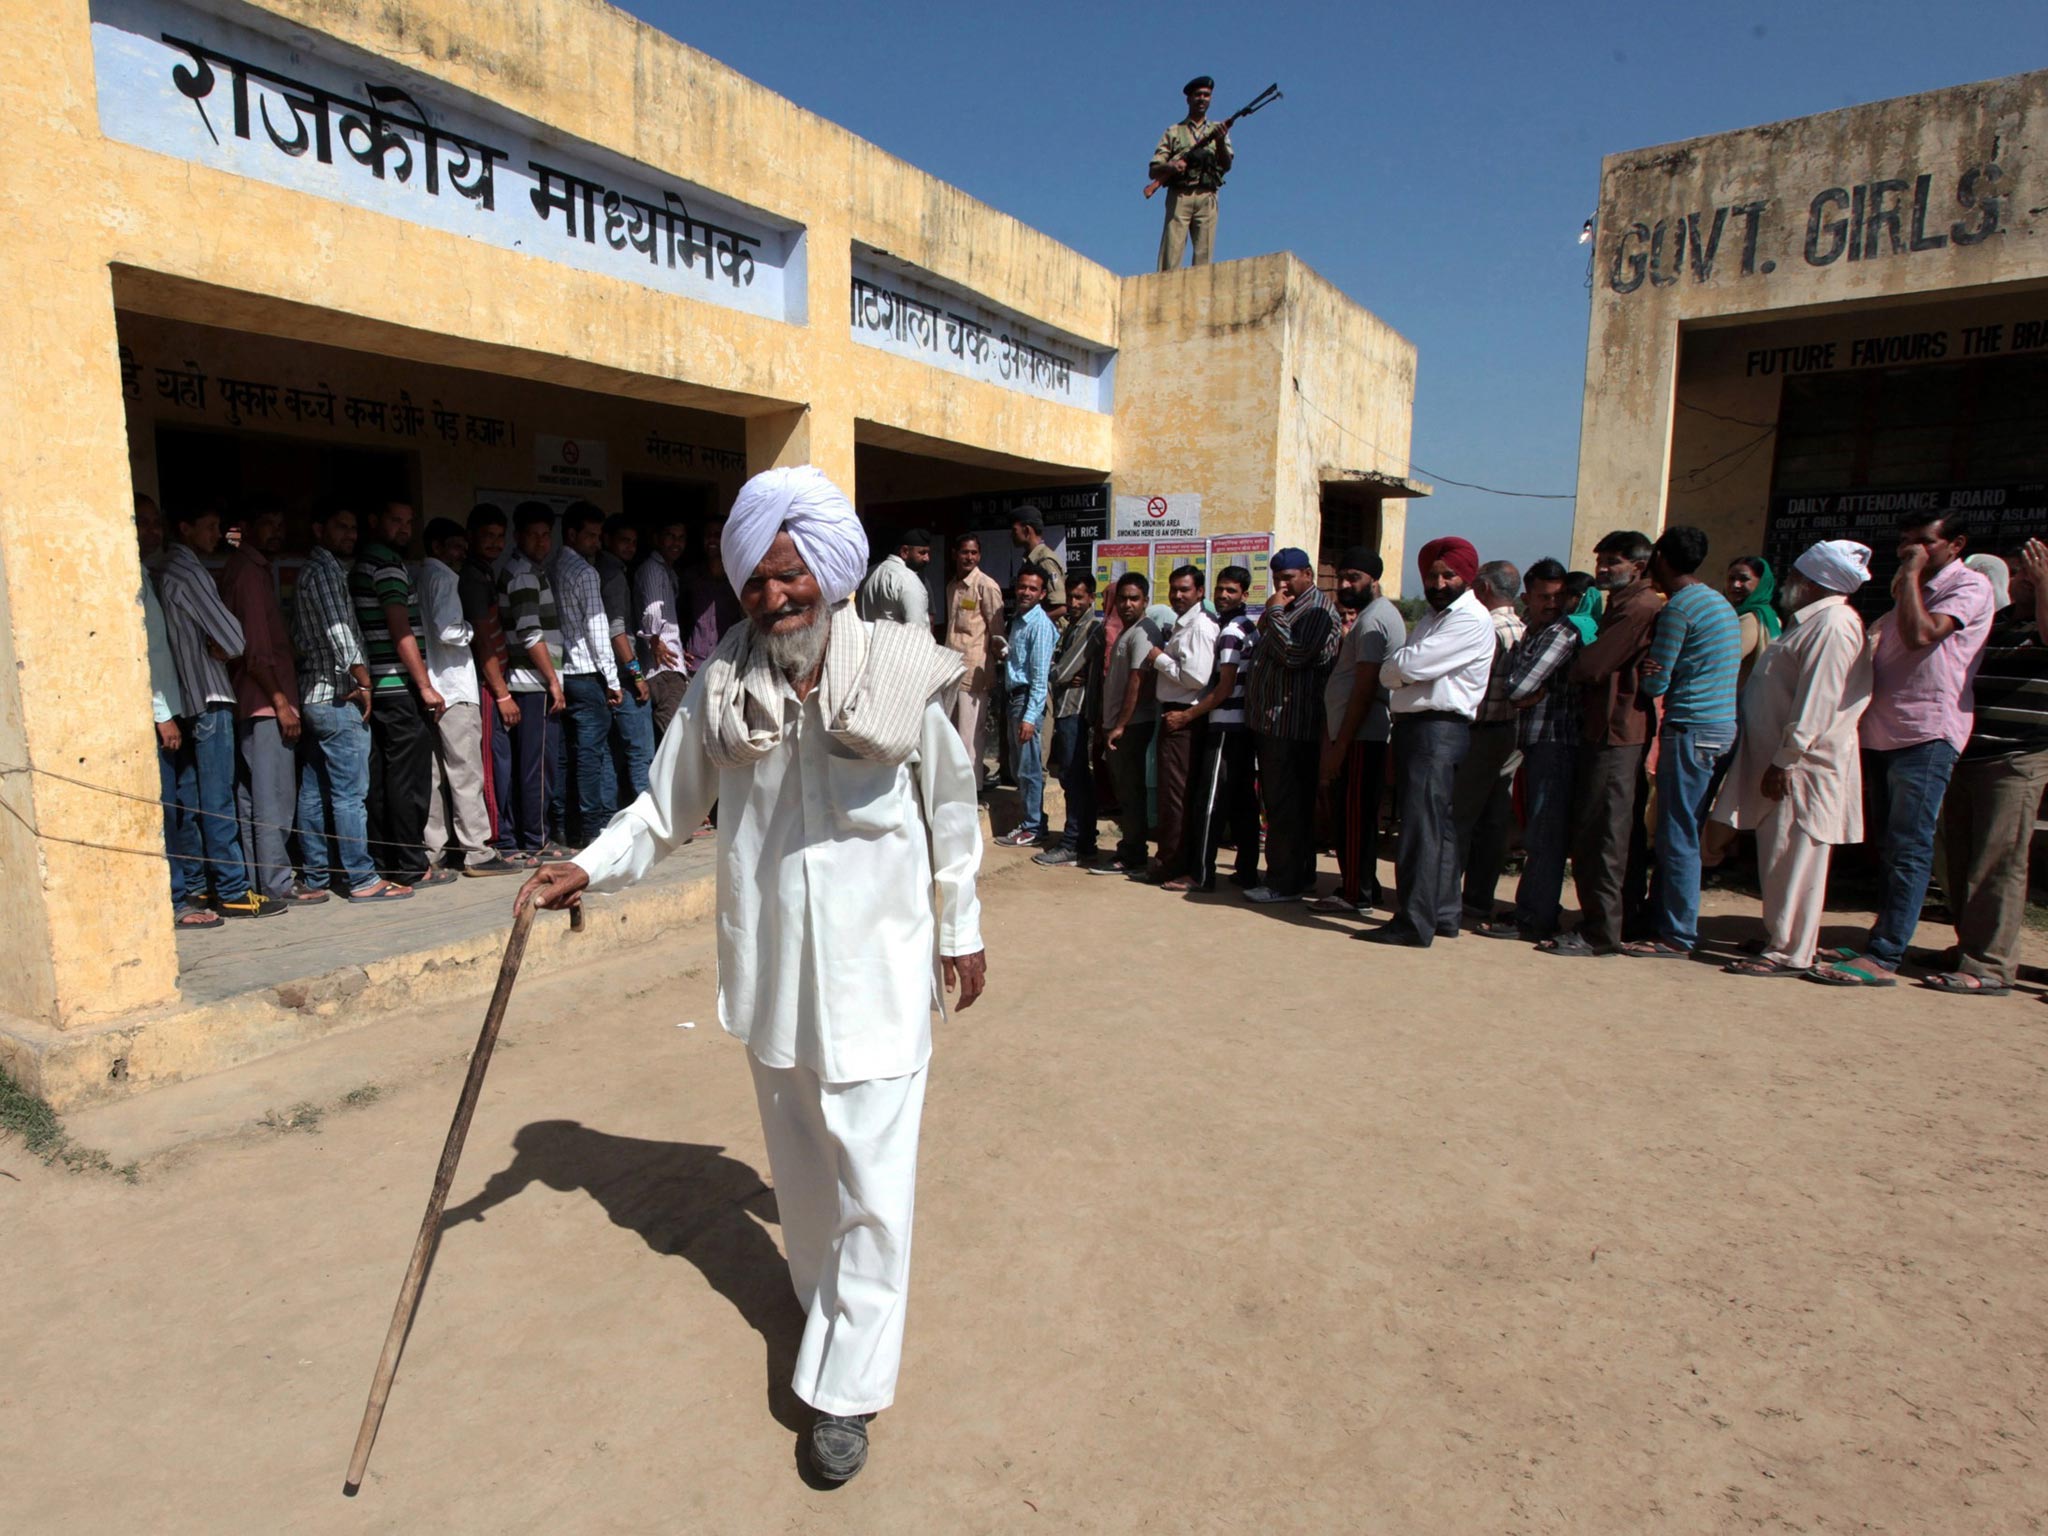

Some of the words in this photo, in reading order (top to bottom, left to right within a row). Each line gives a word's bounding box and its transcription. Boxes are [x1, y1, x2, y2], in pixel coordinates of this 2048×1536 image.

[160, 32, 510, 211] राजकीय
[528, 159, 761, 288] माध्यमिक
[1610, 201, 1776, 295] GOVT.
[1803, 163, 2004, 267] GIRLS
[1746, 342, 1837, 377] FUTURE
[1851, 330, 1948, 367] FAVOURS
[1961, 323, 2004, 355] THE
[217, 377, 282, 426] पुकार
[285, 382, 337, 426] बच्चे
[344, 396, 388, 433] कम
[389, 388, 428, 439] और
[1060, 491, 1099, 509] CHART
[1787, 495, 1831, 514] DAILY
[1837, 491, 1940, 513] ATTENDANCE
[1949, 488, 2007, 508] BOARD
[1080, 525, 1099, 538] RICE
[1117, 529, 1140, 537] SMOKING
[1141, 529, 1154, 537] HERE
[1162, 528, 1170, 536] AN
[1170, 528, 1193, 536] OFFENCE
[1133, 520, 1141, 528] NO
[1142, 519, 1165, 528] SMOKING
[1166, 519, 1181, 527] AREA
